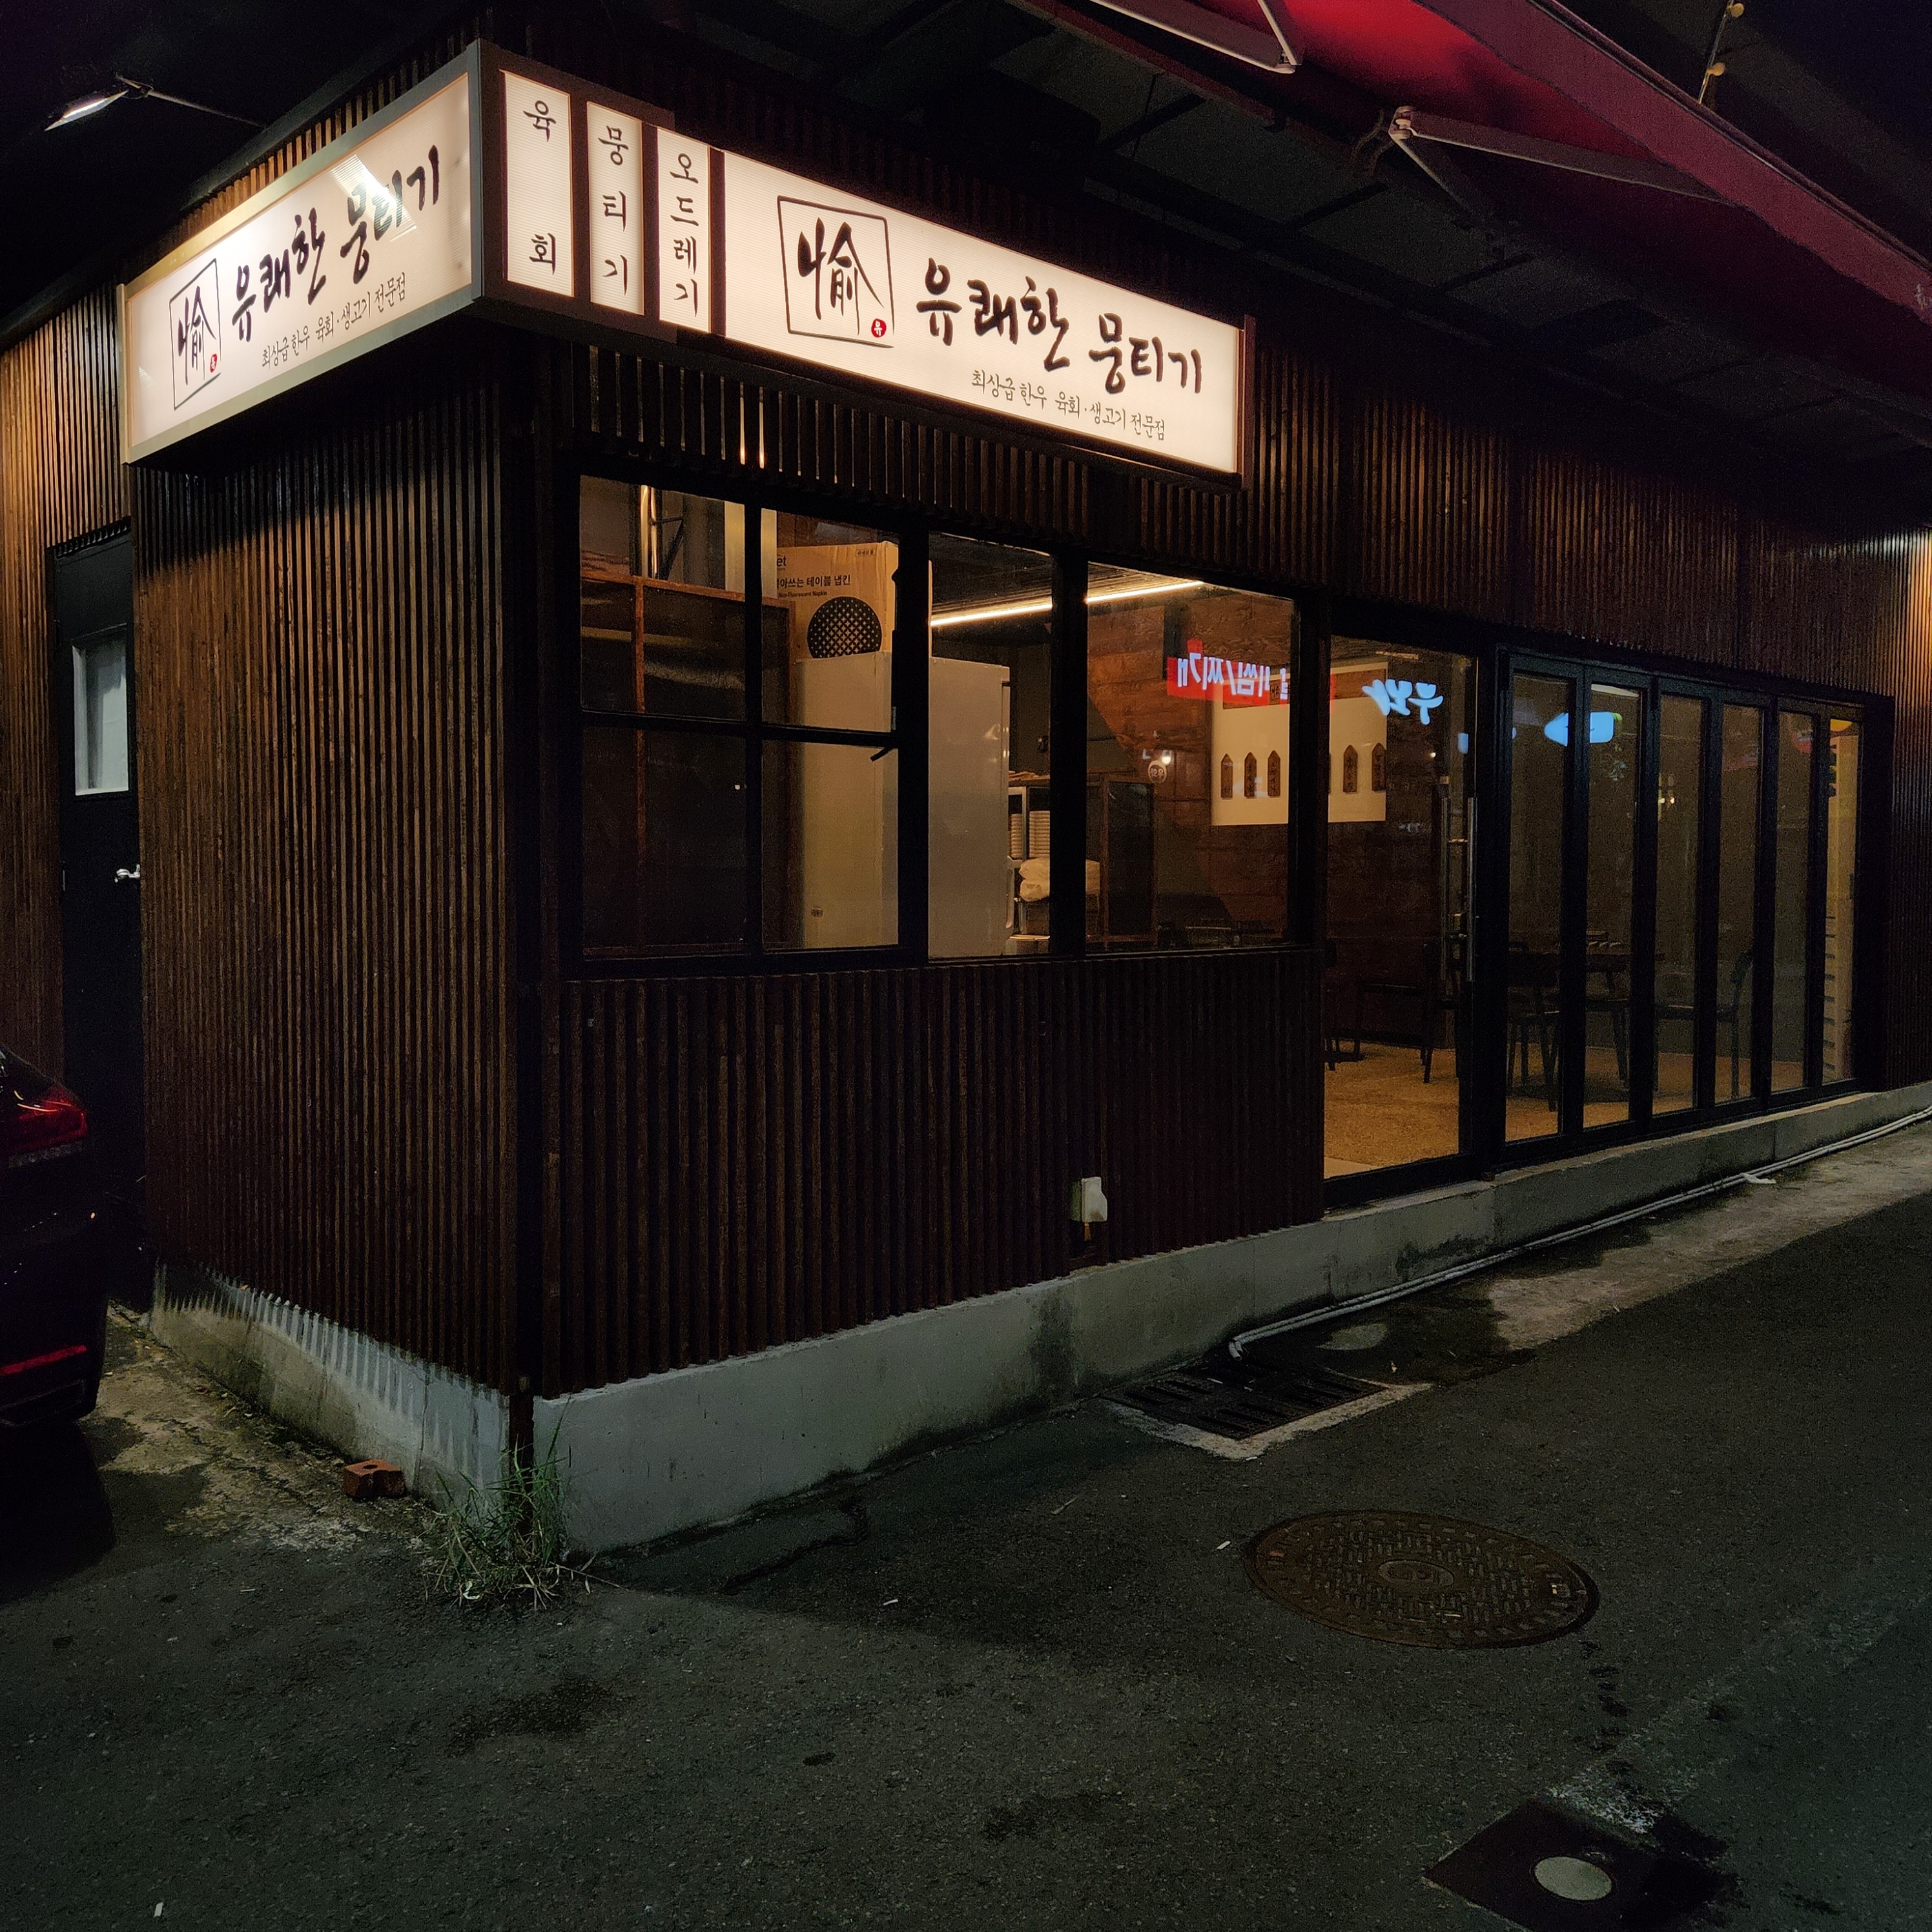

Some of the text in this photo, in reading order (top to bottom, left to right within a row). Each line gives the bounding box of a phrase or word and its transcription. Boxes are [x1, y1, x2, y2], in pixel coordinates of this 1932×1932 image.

[231, 145, 440, 343] 유쾌한 뭉티기
[598, 125, 629, 296] 뭉티기
[669, 153, 699, 318] 오드레기
[262, 337, 289, 369] 최상급
[291, 325, 311, 356] 한우
[374, 272, 406, 313] 전문점
[916, 257, 1202, 395] 유쾌한 뭉티기
[971, 369, 1016, 402] 최상급
[1019, 382, 1047, 410] 한우
[1131, 413, 1166, 441] 전문점
[807, 576, 832, 587] 테이블
[834, 574, 850, 586] 냅킨
